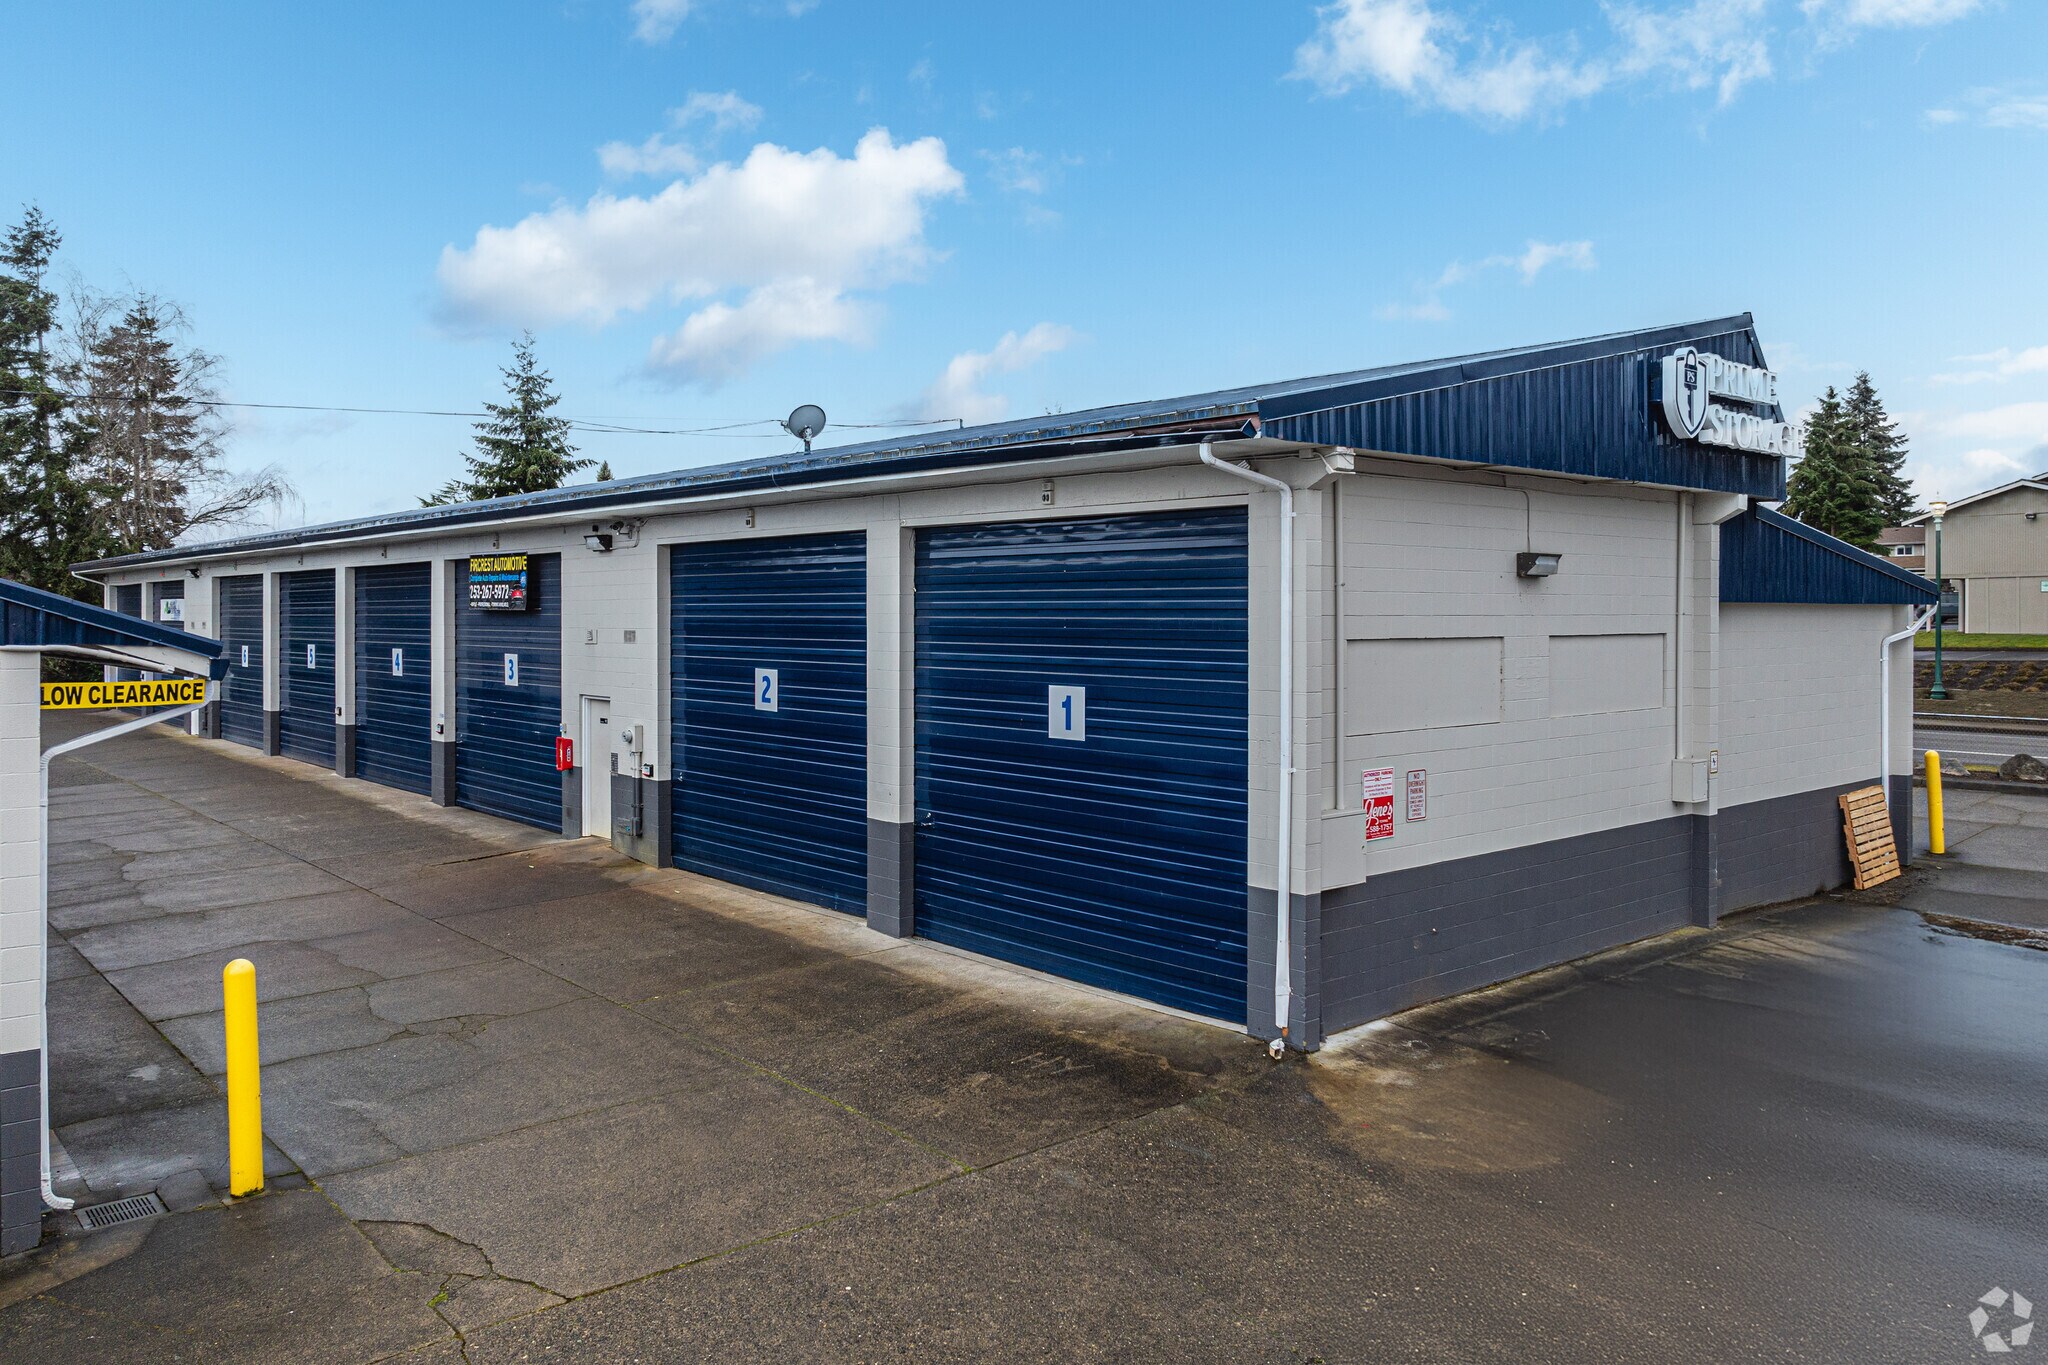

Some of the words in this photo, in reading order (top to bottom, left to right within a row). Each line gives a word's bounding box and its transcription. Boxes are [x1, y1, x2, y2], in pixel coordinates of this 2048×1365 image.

[1686, 371, 1696, 383] PS
[1707, 352, 1778, 405] PRIME
[1702, 404, 1806, 458] STORAGE
[494, 556, 527, 571] AUTOMOTIVE
[470, 584, 509, 599] 253-267-5972
[309, 648, 313, 664] 5
[395, 653, 400, 671] 4
[508, 659, 514, 680] 3
[41, 685, 83, 706] LOW
[88, 682, 203, 705] CLEARANCE
[761, 675, 771, 703] 2
[1061, 695, 1071, 731] 1
